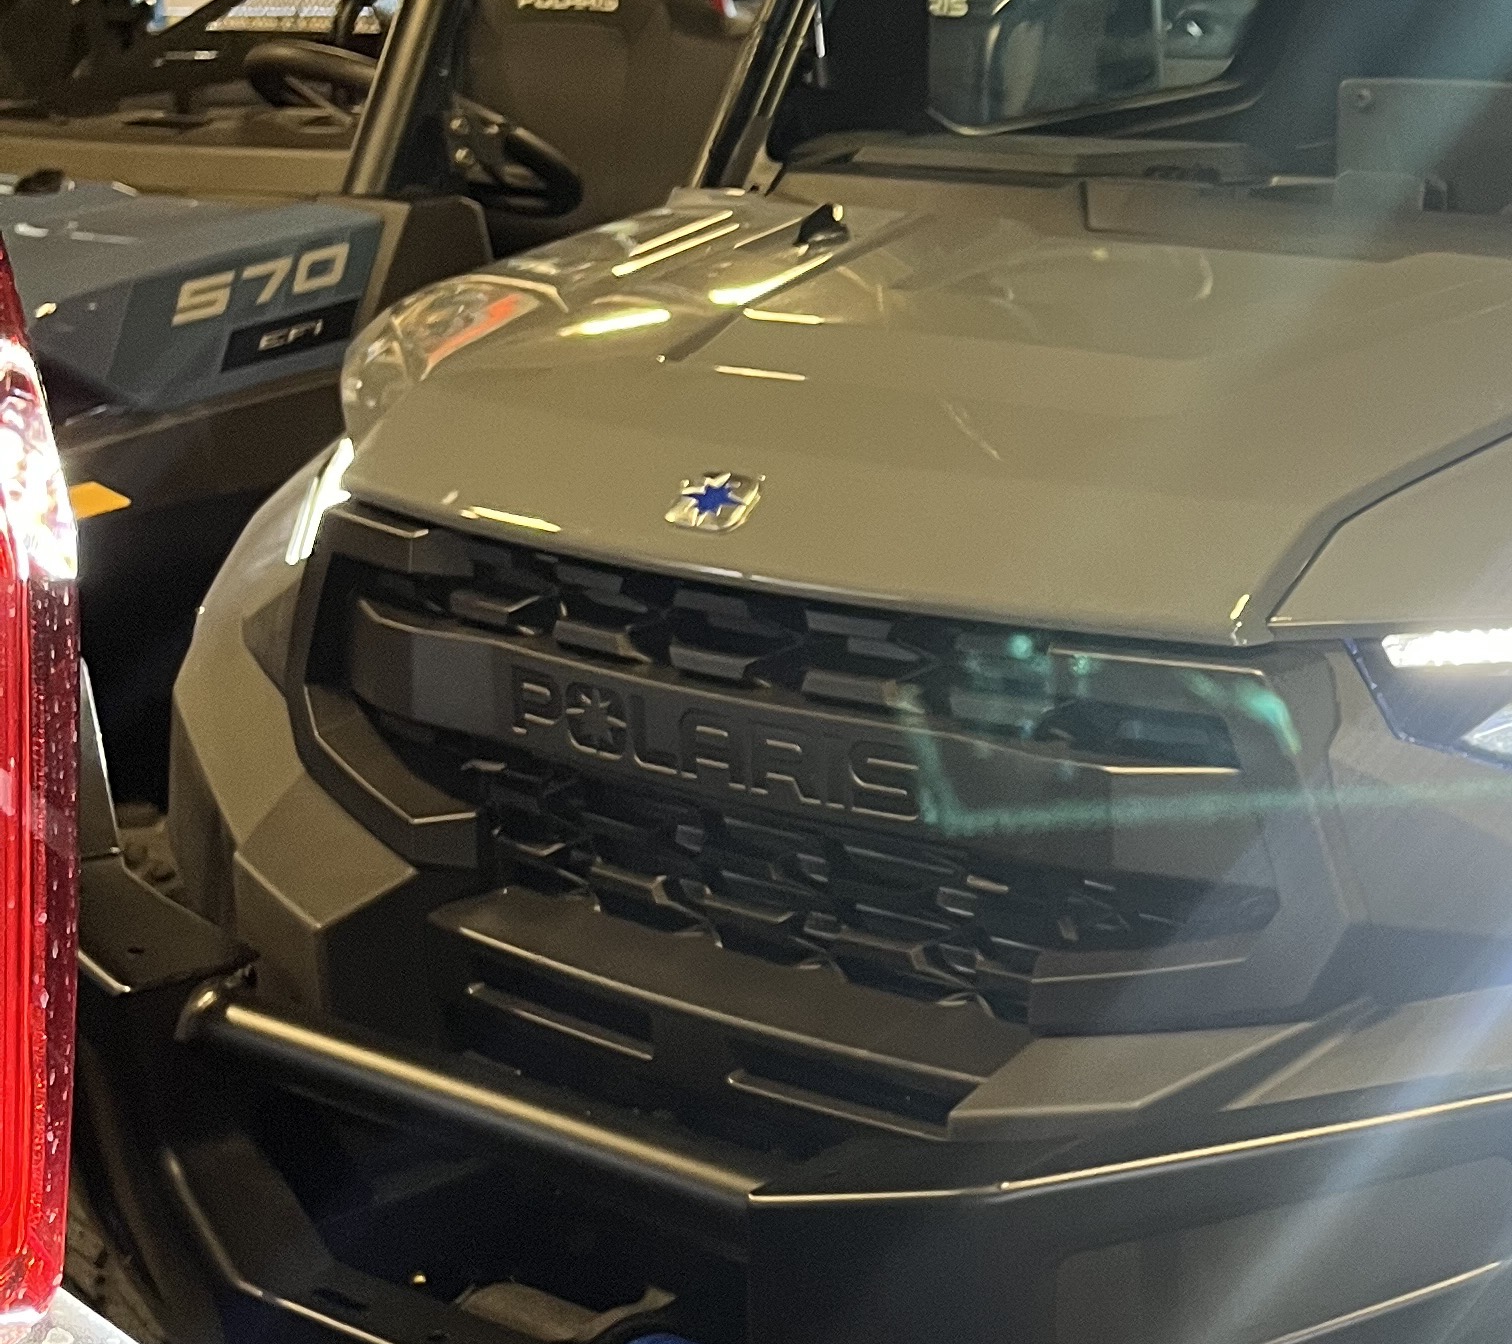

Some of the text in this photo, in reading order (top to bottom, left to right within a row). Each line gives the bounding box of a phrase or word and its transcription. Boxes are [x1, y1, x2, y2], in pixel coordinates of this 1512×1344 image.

[170, 242, 350, 328] 570
[258, 318, 324, 352] EFI
[510, 663, 921, 823] POLARIS
